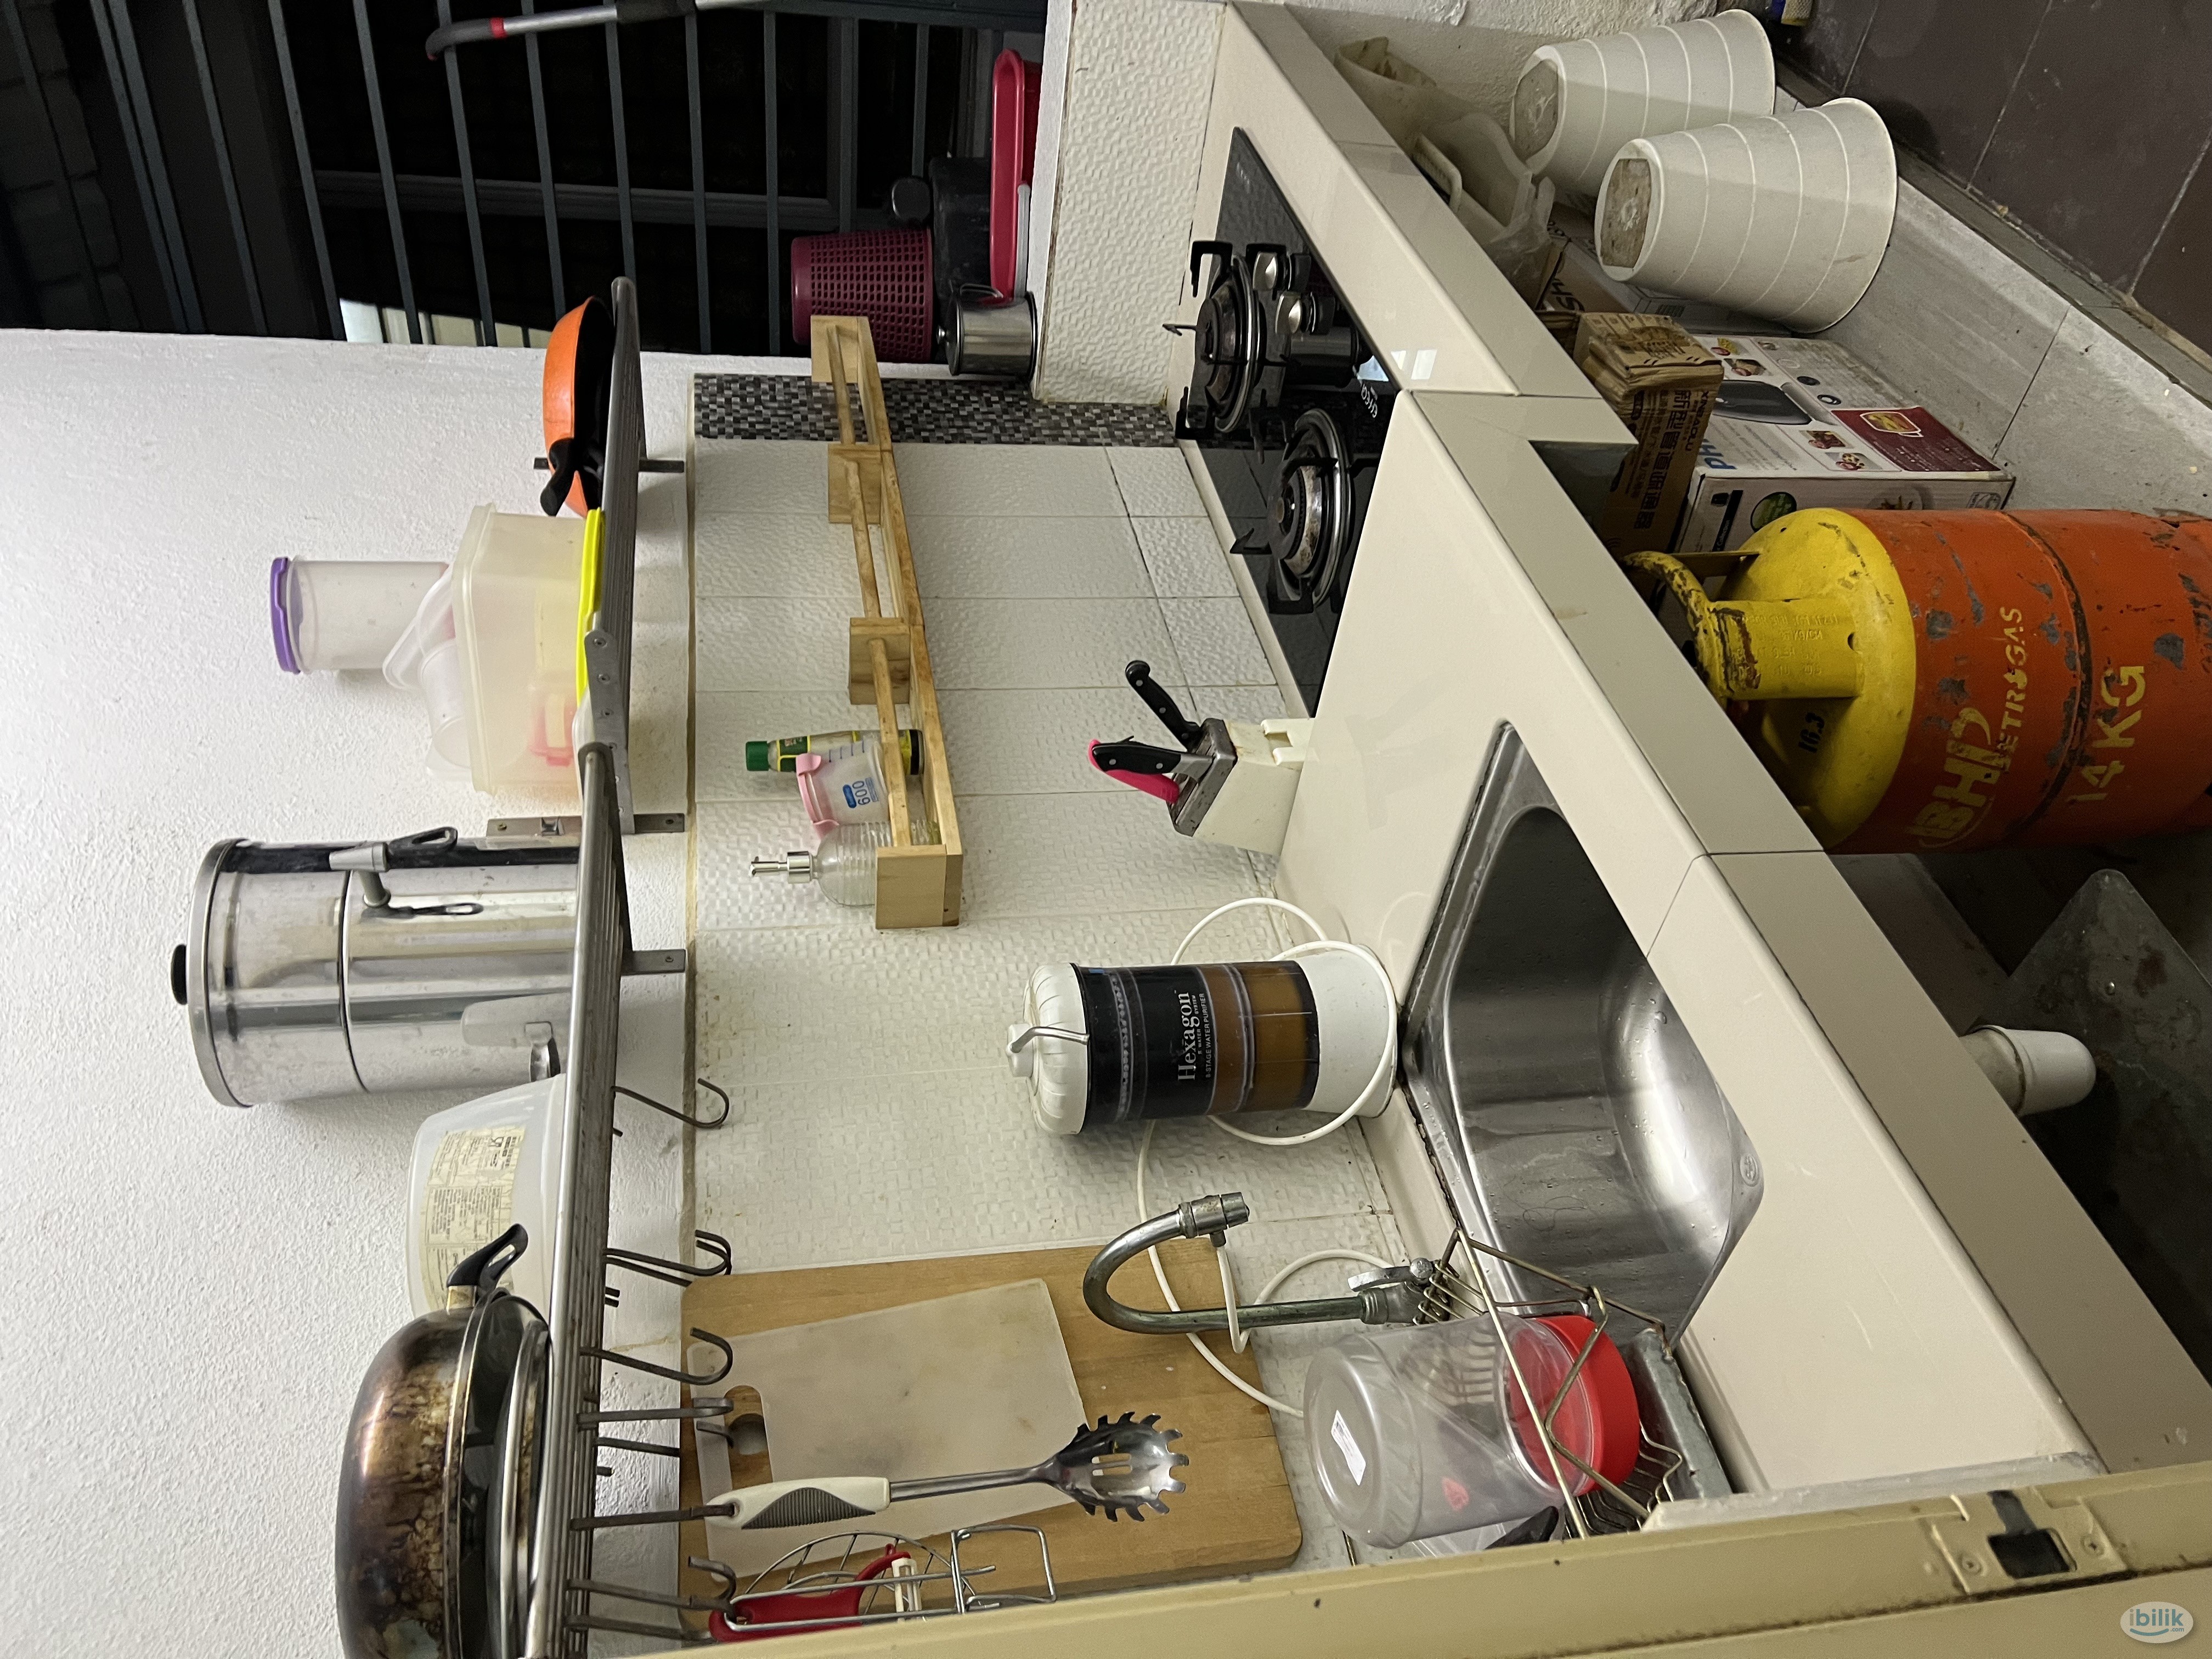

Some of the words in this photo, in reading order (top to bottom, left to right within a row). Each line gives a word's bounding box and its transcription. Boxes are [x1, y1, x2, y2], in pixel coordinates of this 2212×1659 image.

[2092, 665, 2145, 748] KG
[852, 781, 870, 805] 600
[2064, 760, 2125, 802] 14
[1199, 993, 1209, 1022] PURIFIER
[1177, 992, 1200, 1080] Hexagon
